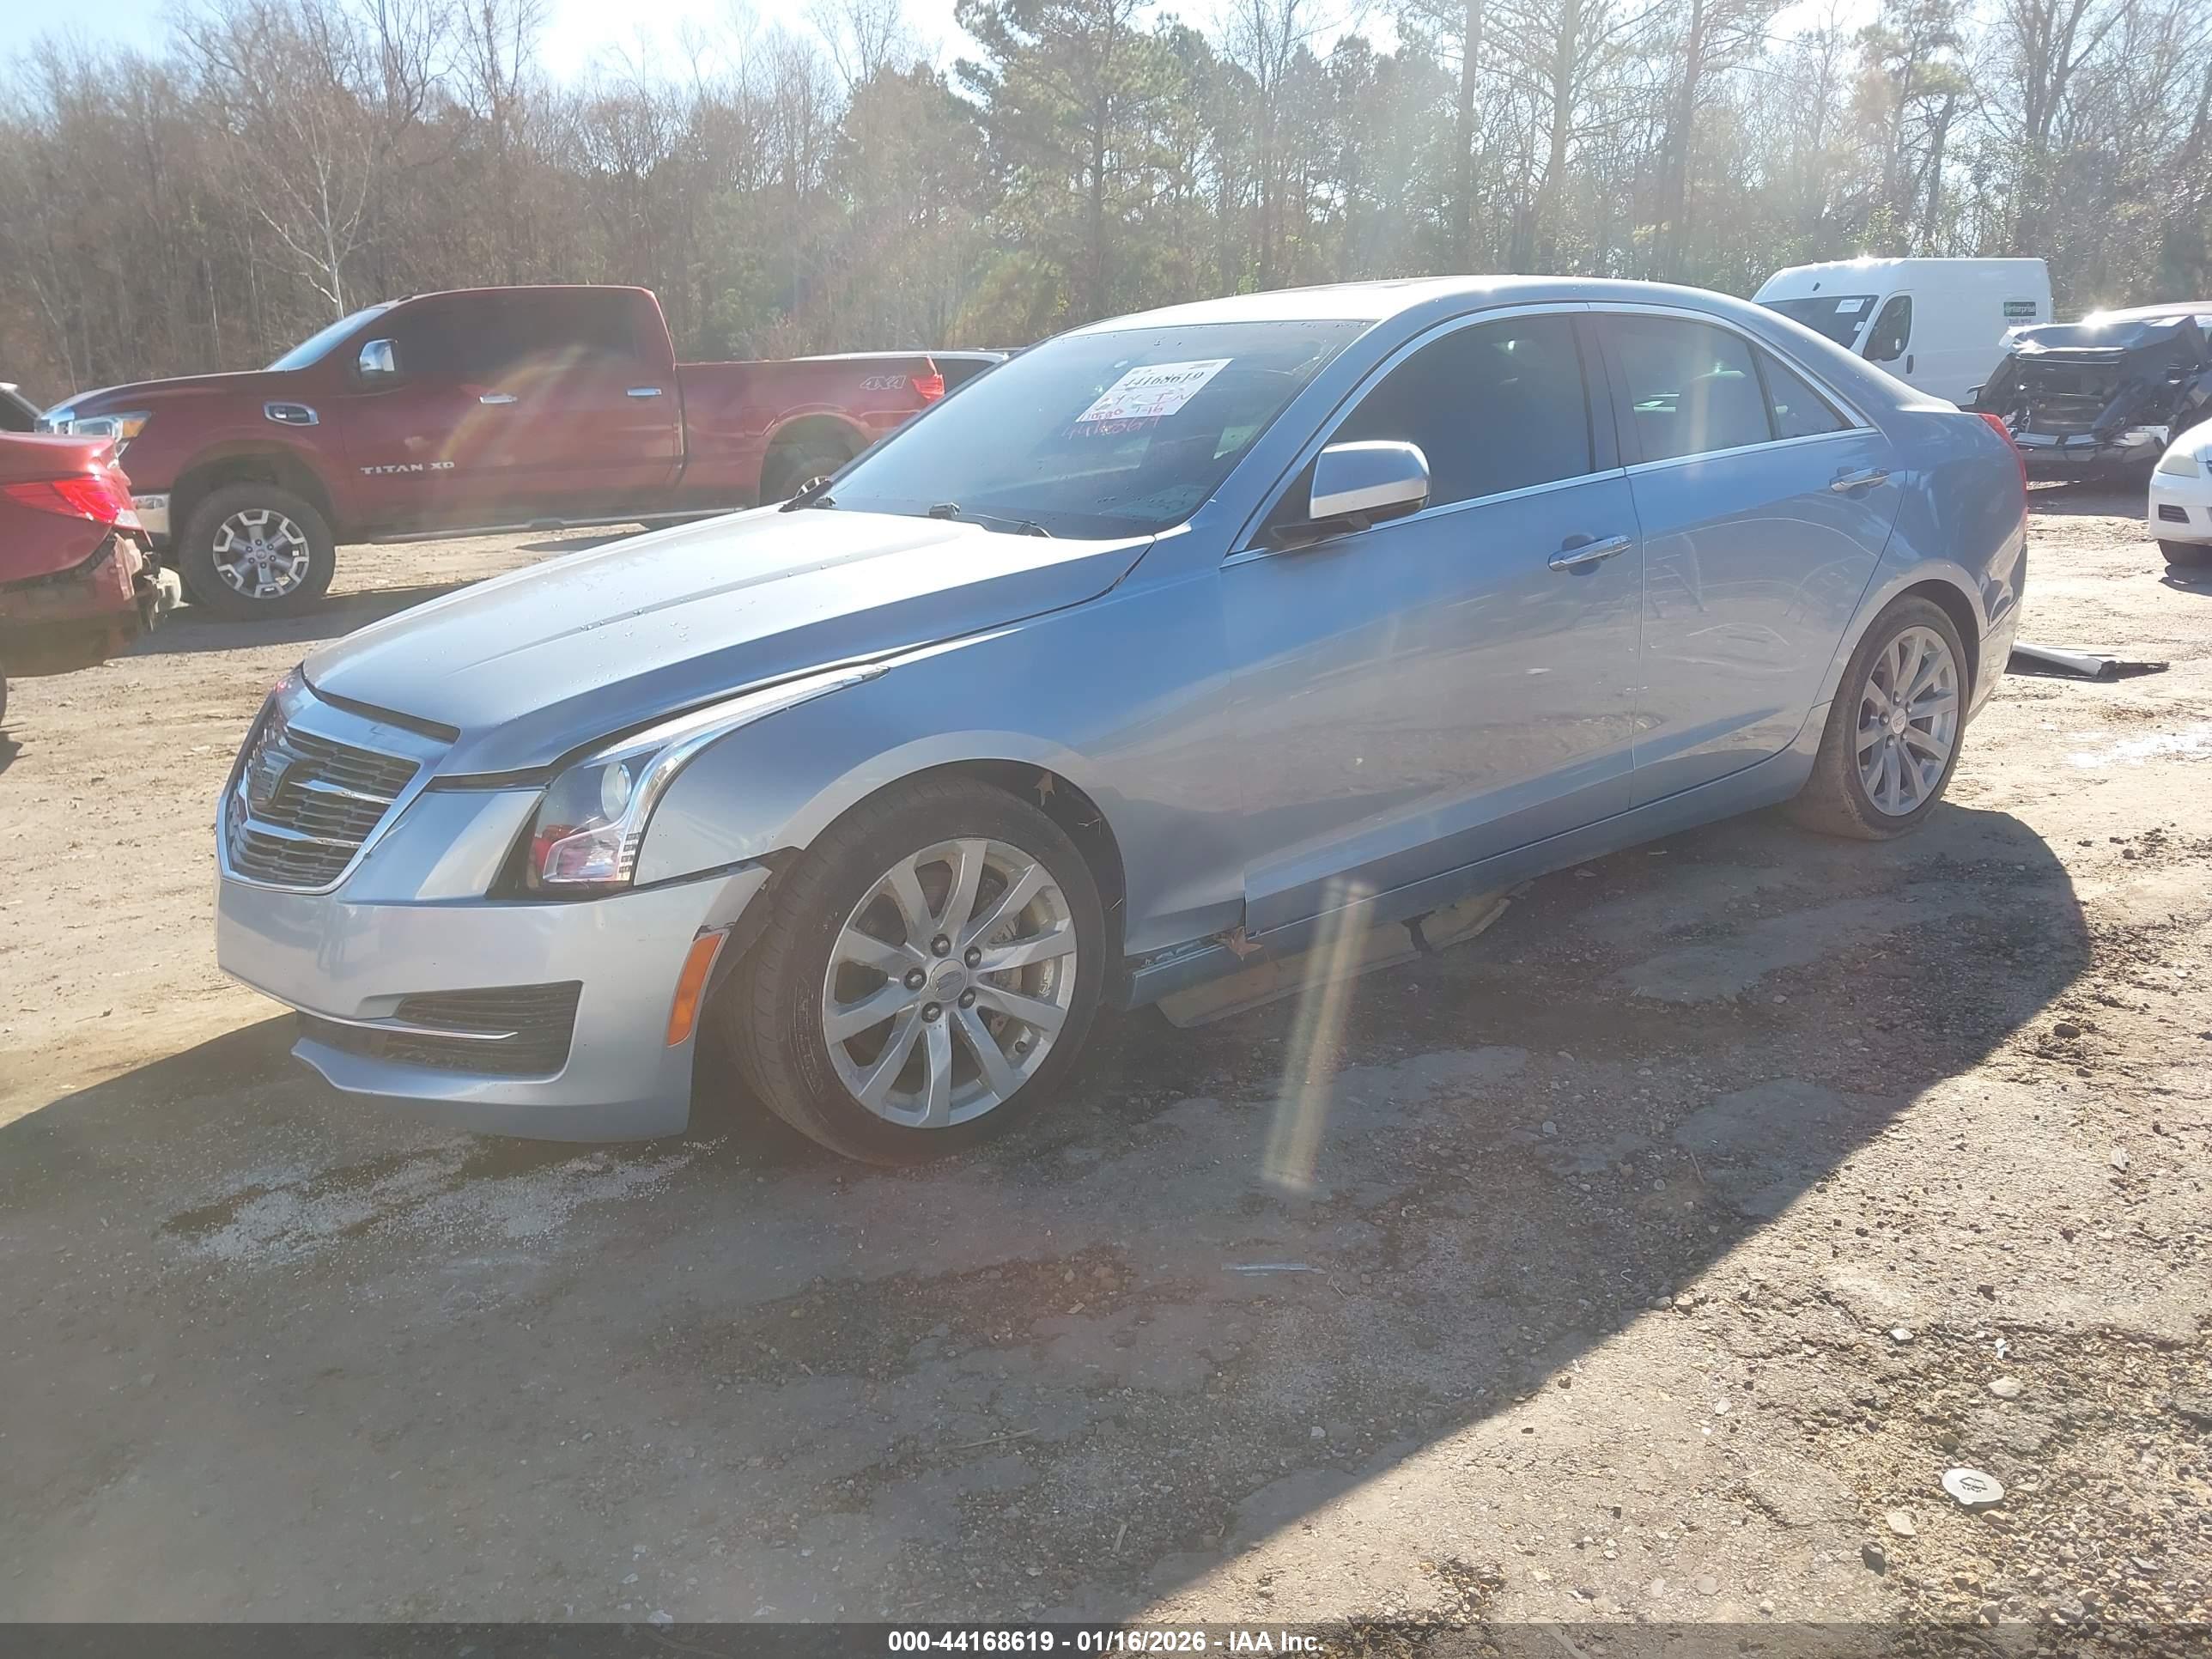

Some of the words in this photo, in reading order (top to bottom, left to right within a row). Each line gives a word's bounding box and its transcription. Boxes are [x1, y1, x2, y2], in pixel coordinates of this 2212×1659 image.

[859, 375, 906, 390] 4X4
[1122, 371, 1204, 387] 44168619
[360, 463, 424, 475] TITAN
[430, 461, 455, 471] XD
